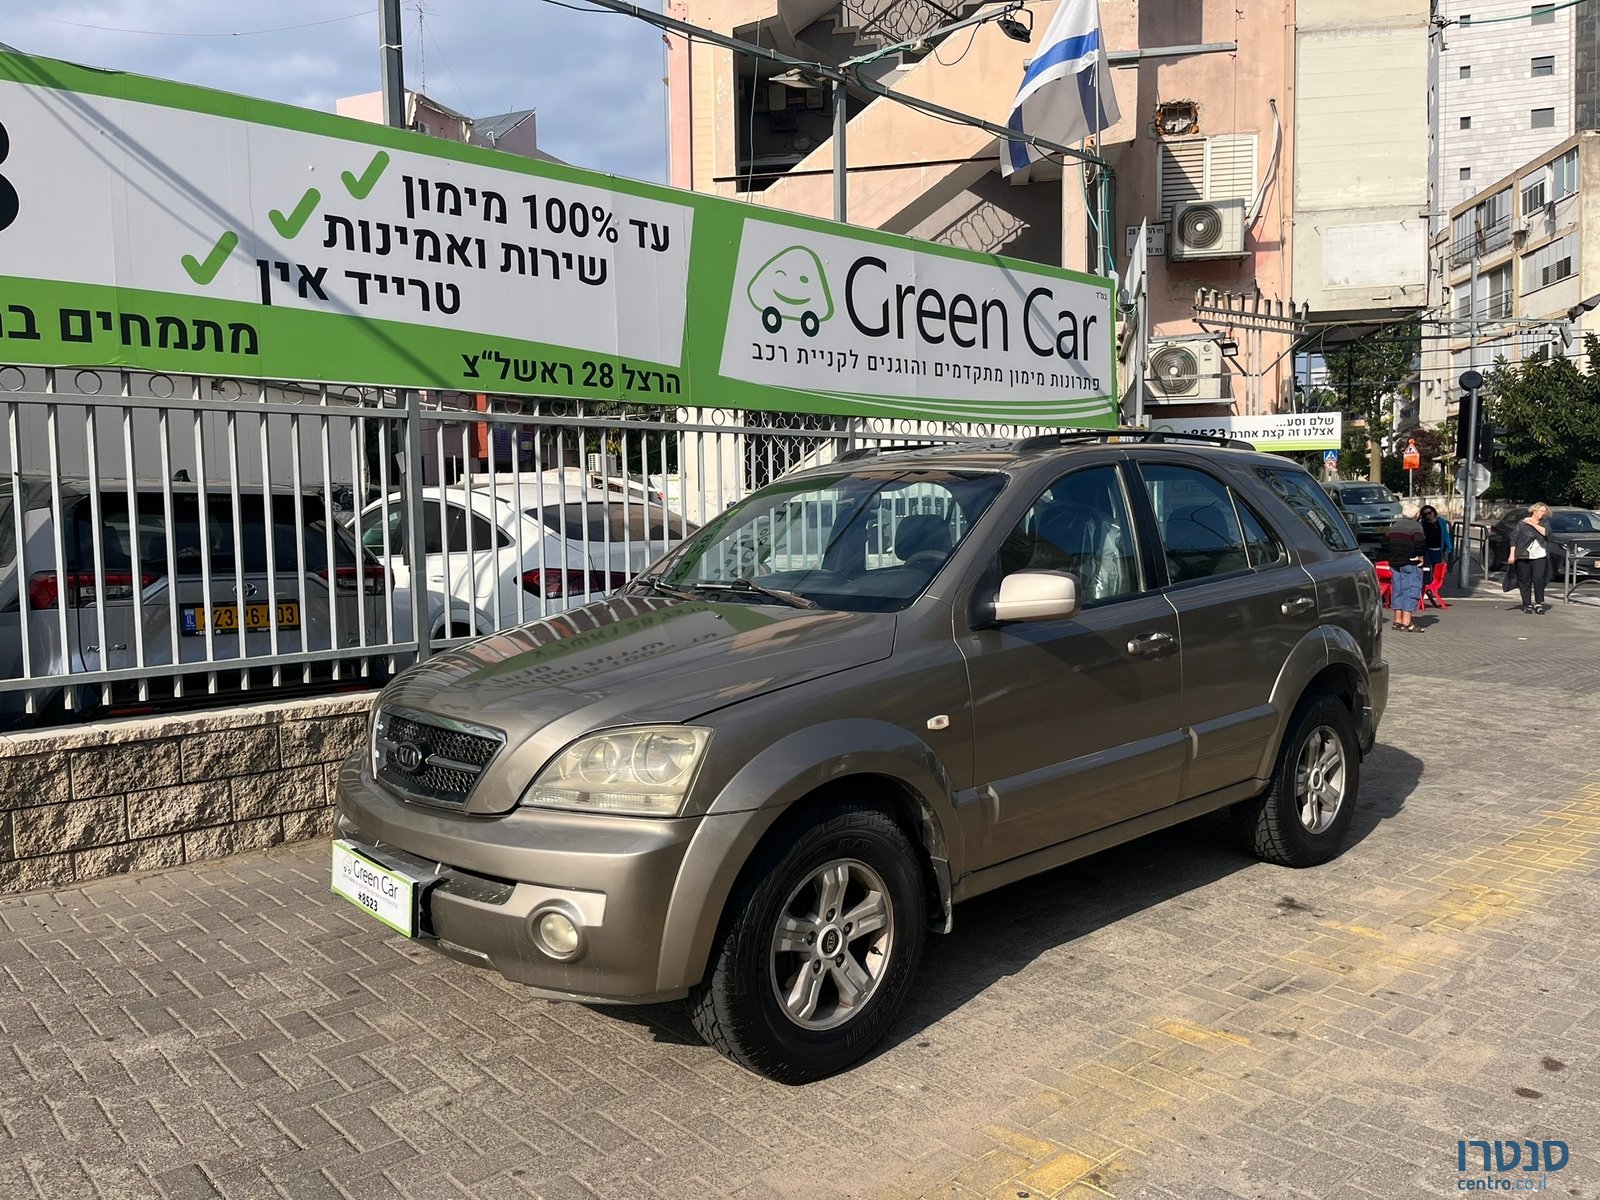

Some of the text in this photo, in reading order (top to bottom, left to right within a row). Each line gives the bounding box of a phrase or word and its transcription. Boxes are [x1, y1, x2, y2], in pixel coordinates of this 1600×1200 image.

[403, 175, 670, 252] עד 100% מימון
[324, 214, 607, 286] שירות ואמינות
[257, 259, 461, 315] טרייד אין
[845, 256, 1097, 361] Green Car
[0, 304, 259, 355] מתמחים ב
[582, 360, 614, 389] 28
[621, 361, 681, 395] הרצל
[752, 342, 1100, 391] פתרונות מימון מתקדמים והוגנים לקניית רכב
[1230, 430, 1259, 439] אחרת
[1261, 429, 1285, 439] קצת
[1303, 427, 1334, 436] אצלנו
[1309, 417, 1335, 426] שלם
[353, 859, 379, 890] Green
[381, 875, 399, 899] Car
